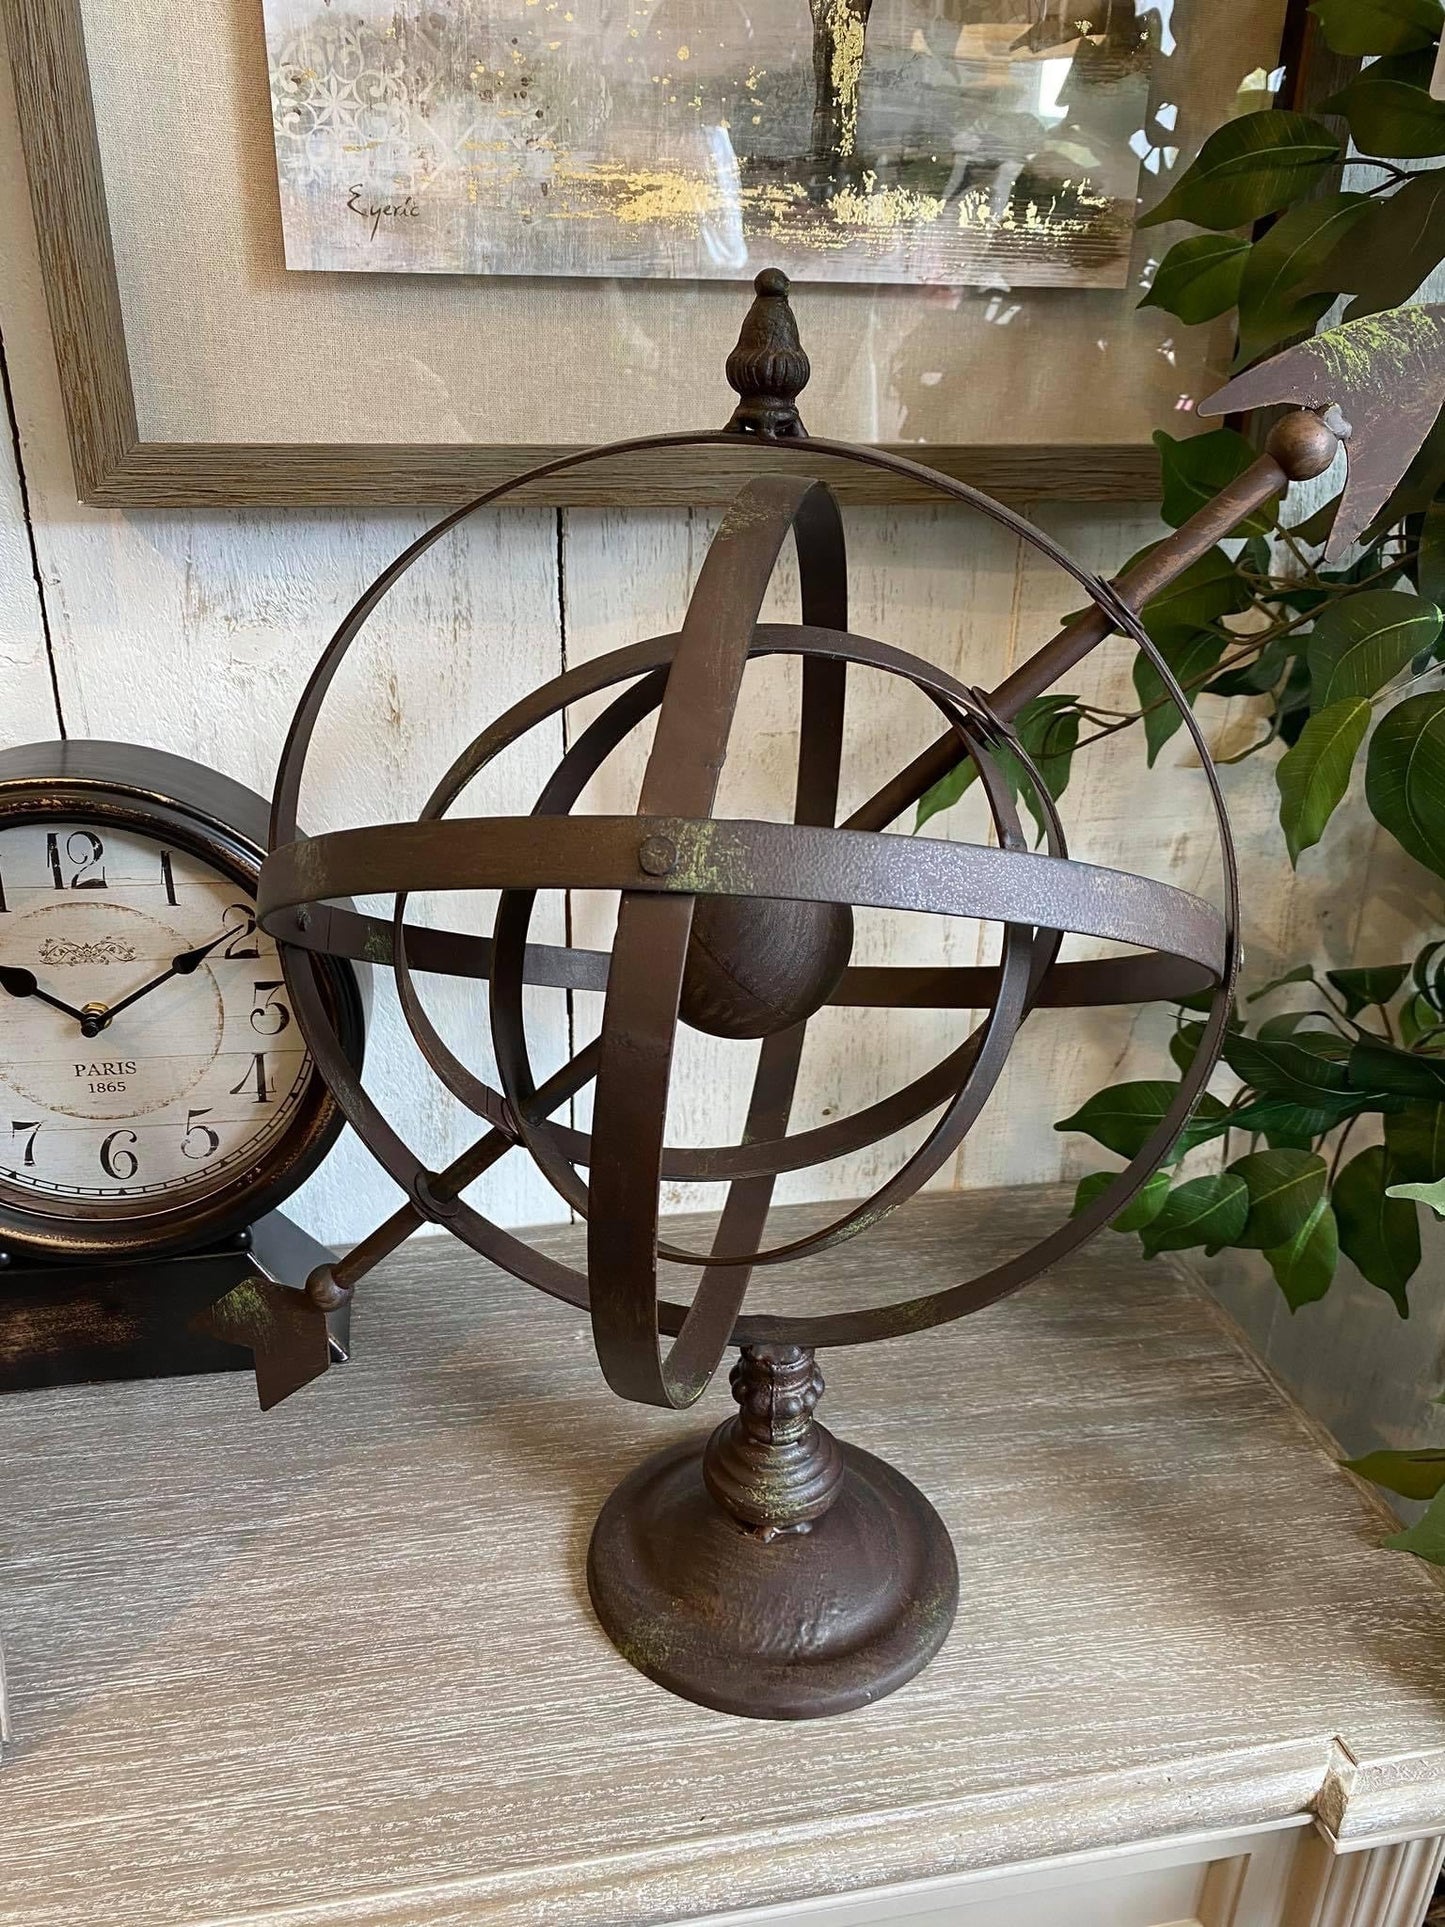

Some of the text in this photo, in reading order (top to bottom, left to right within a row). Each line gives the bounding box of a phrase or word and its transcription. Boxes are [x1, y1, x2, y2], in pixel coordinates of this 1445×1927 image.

[46, 830, 108, 890] 12
[160, 850, 181, 906] 1
[222, 903, 261, 959] 2
[250, 980, 290, 1036] 3
[73, 1061, 137, 1077] PARIS
[88, 1081, 126, 1093] 1865
[229, 1052, 277, 1104] 4
[11, 1120, 46, 1166] 7
[100, 1129, 139, 1180] 6
[180, 1107, 220, 1159] 5
